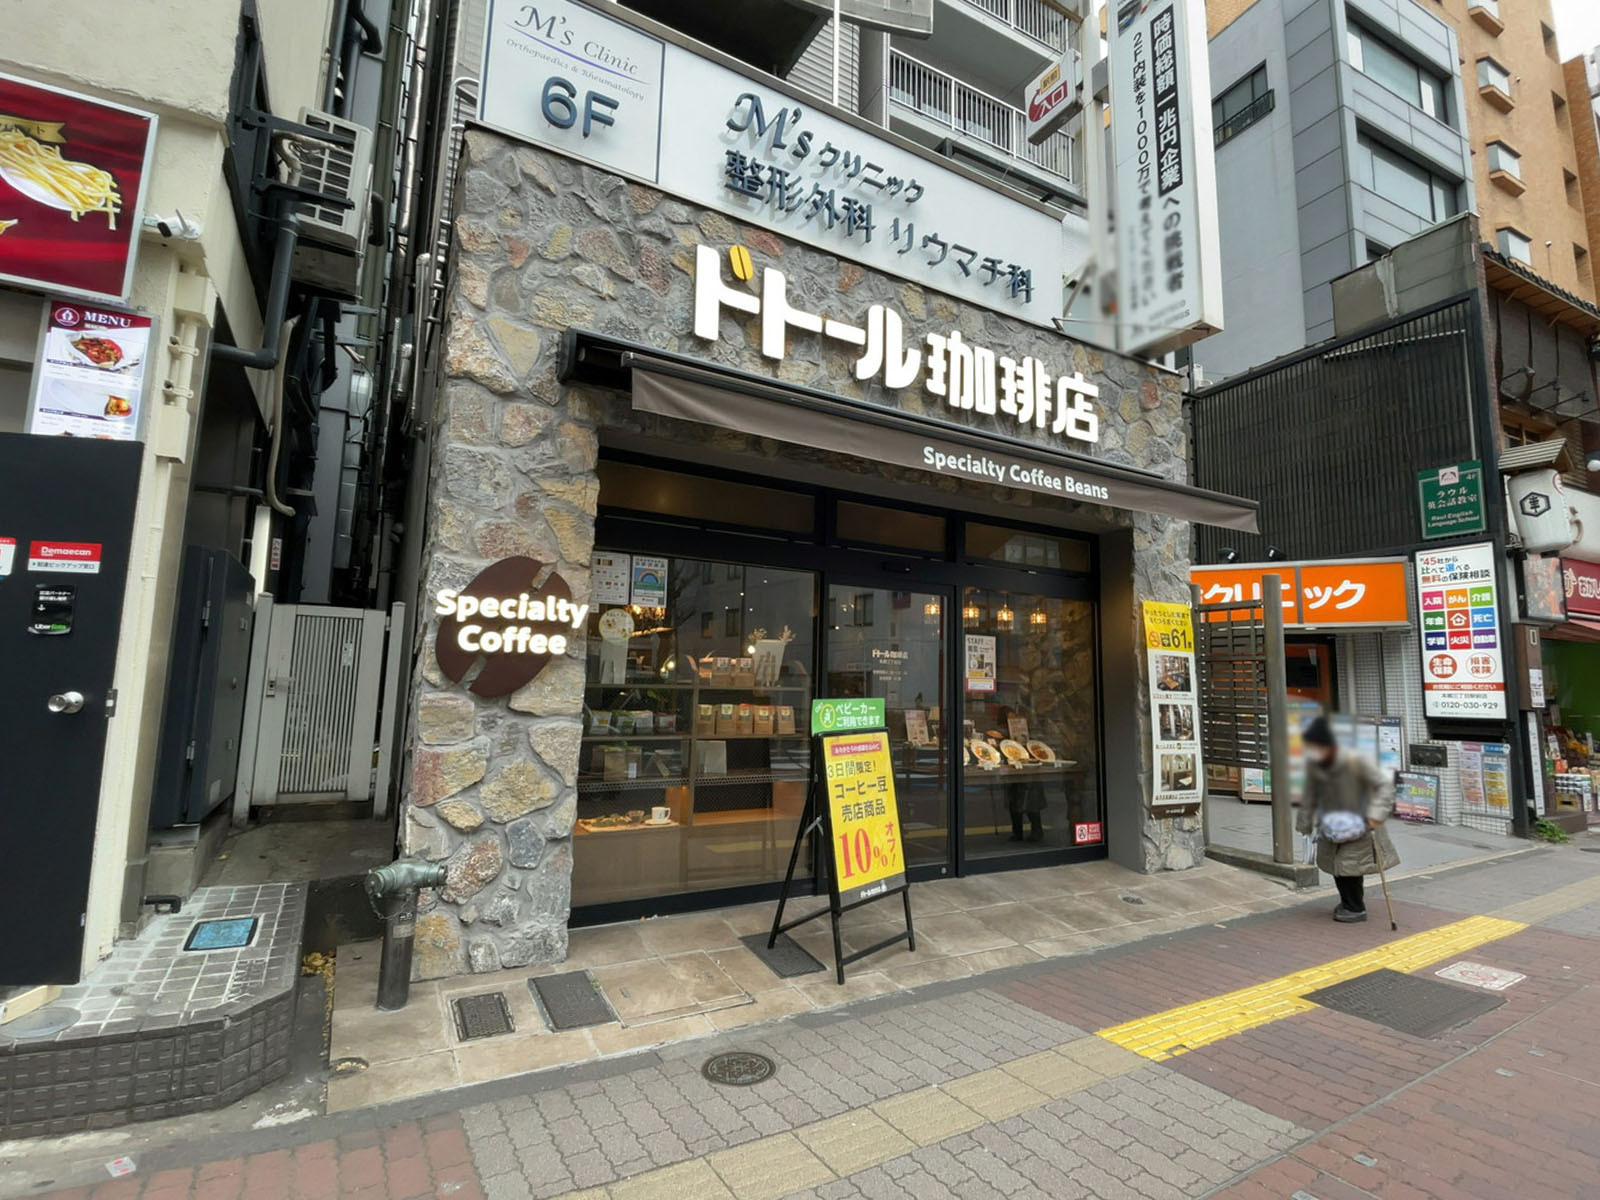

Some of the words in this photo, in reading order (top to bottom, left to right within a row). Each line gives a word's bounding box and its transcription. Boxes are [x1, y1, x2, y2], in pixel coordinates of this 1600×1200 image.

[514, 5, 575, 46] M's
[584, 41, 638, 75] Clinic
[506, 38, 569, 70] Orthopaedics
[581, 69, 645, 102] Rheumatology
[541, 76, 620, 139] 6F
[724, 149, 876, 244] 整形外科
[890, 216, 1034, 304] リウマチ科
[83, 311, 132, 329] MENU
[694, 244, 1100, 443] ドトール珈琲店
[923, 446, 1006, 482] Specialty
[1010, 464, 1062, 491] Coffee
[1065, 476, 1110, 500] Beans
[1421, 570, 1491, 583] 無料の保険相談
[435, 588, 590, 629] Specialty
[1448, 594, 1467, 604] がん
[457, 624, 568, 655] Coffee
[836, 703, 877, 715] ベビーカー
[1441, 701, 1499, 710] 0120-030-929
[834, 776, 889, 799] コーヒー豆
[841, 798, 886, 823] 売店商品
[839, 827, 889, 880] 10%
